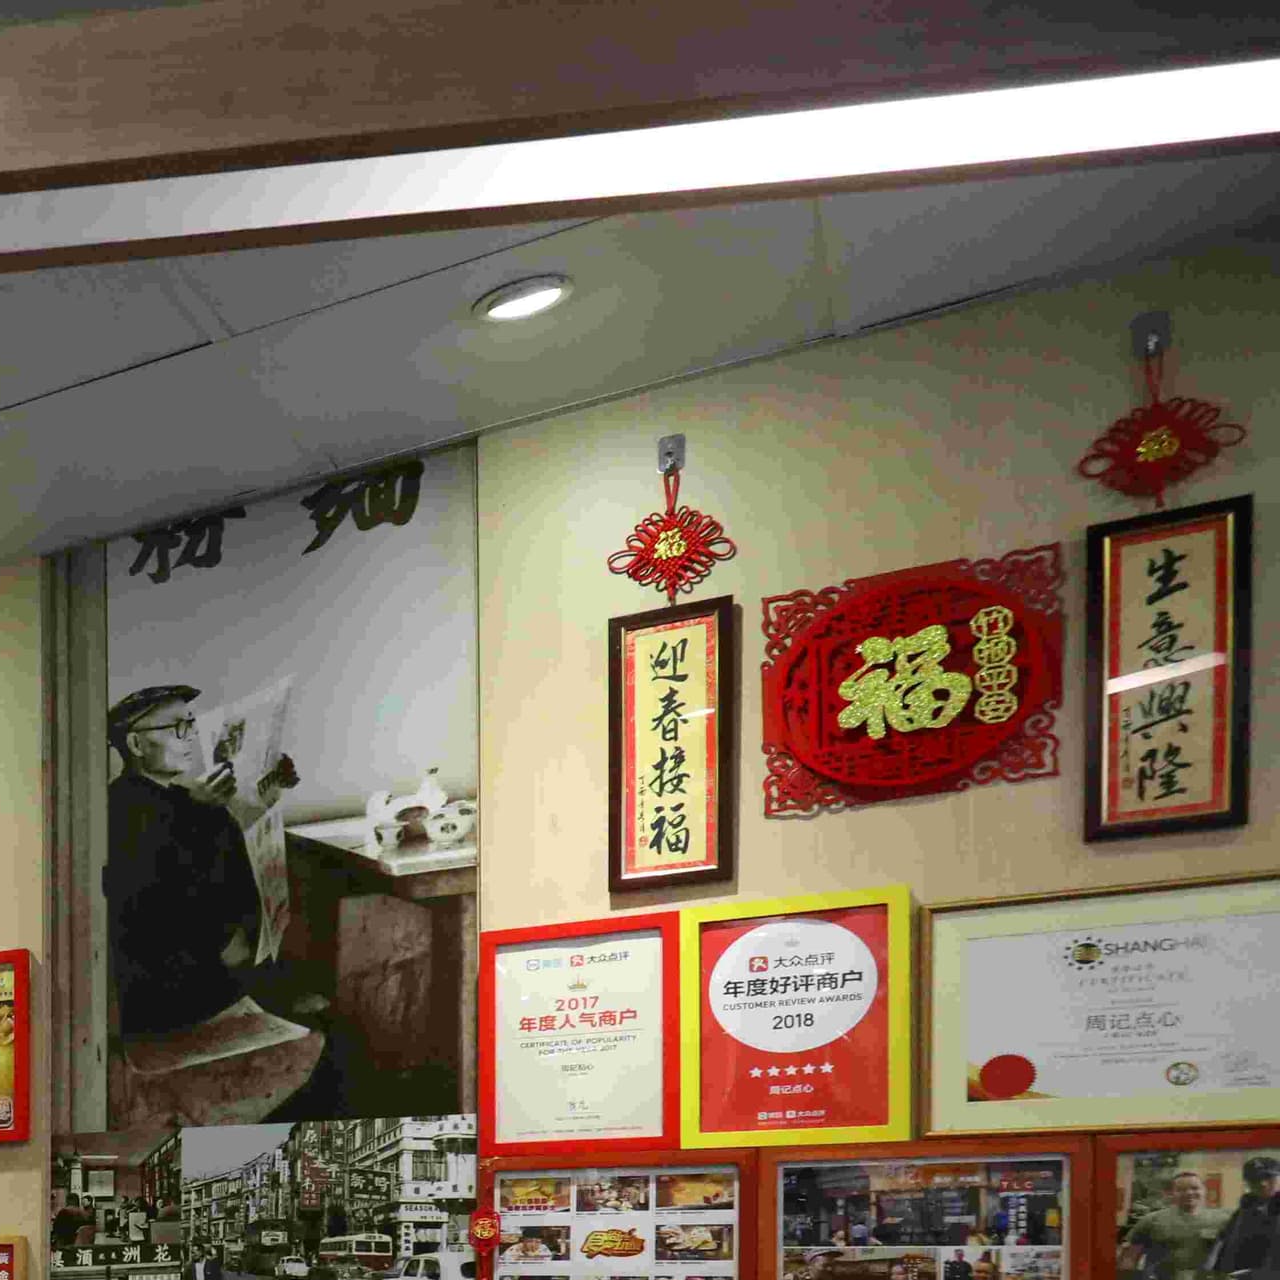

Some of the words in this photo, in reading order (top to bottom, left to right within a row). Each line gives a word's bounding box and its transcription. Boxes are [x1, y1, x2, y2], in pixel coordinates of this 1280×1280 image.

[837, 624, 973, 740] 福
[1131, 548, 1196, 801] 生意興隆
[648, 638, 691, 855] 迎春接福
[774, 952, 835, 968] 大众点评
[723, 970, 863, 998] 年度好评商户
[555, 996, 599, 1012] 2017
[723, 1001, 776, 1011] CUSTOMER
[778, 997, 816, 1007] REVIEW
[819, 993, 863, 1004] AWARDS
[518, 1009, 637, 1032] 年度人气商户
[772, 1013, 815, 1030] 2018
[1086, 1011, 1181, 1032] 周记点心
[520, 1040, 568, 1049] CERTIFICATE
[586, 1035, 637, 1045] POPULARITY
